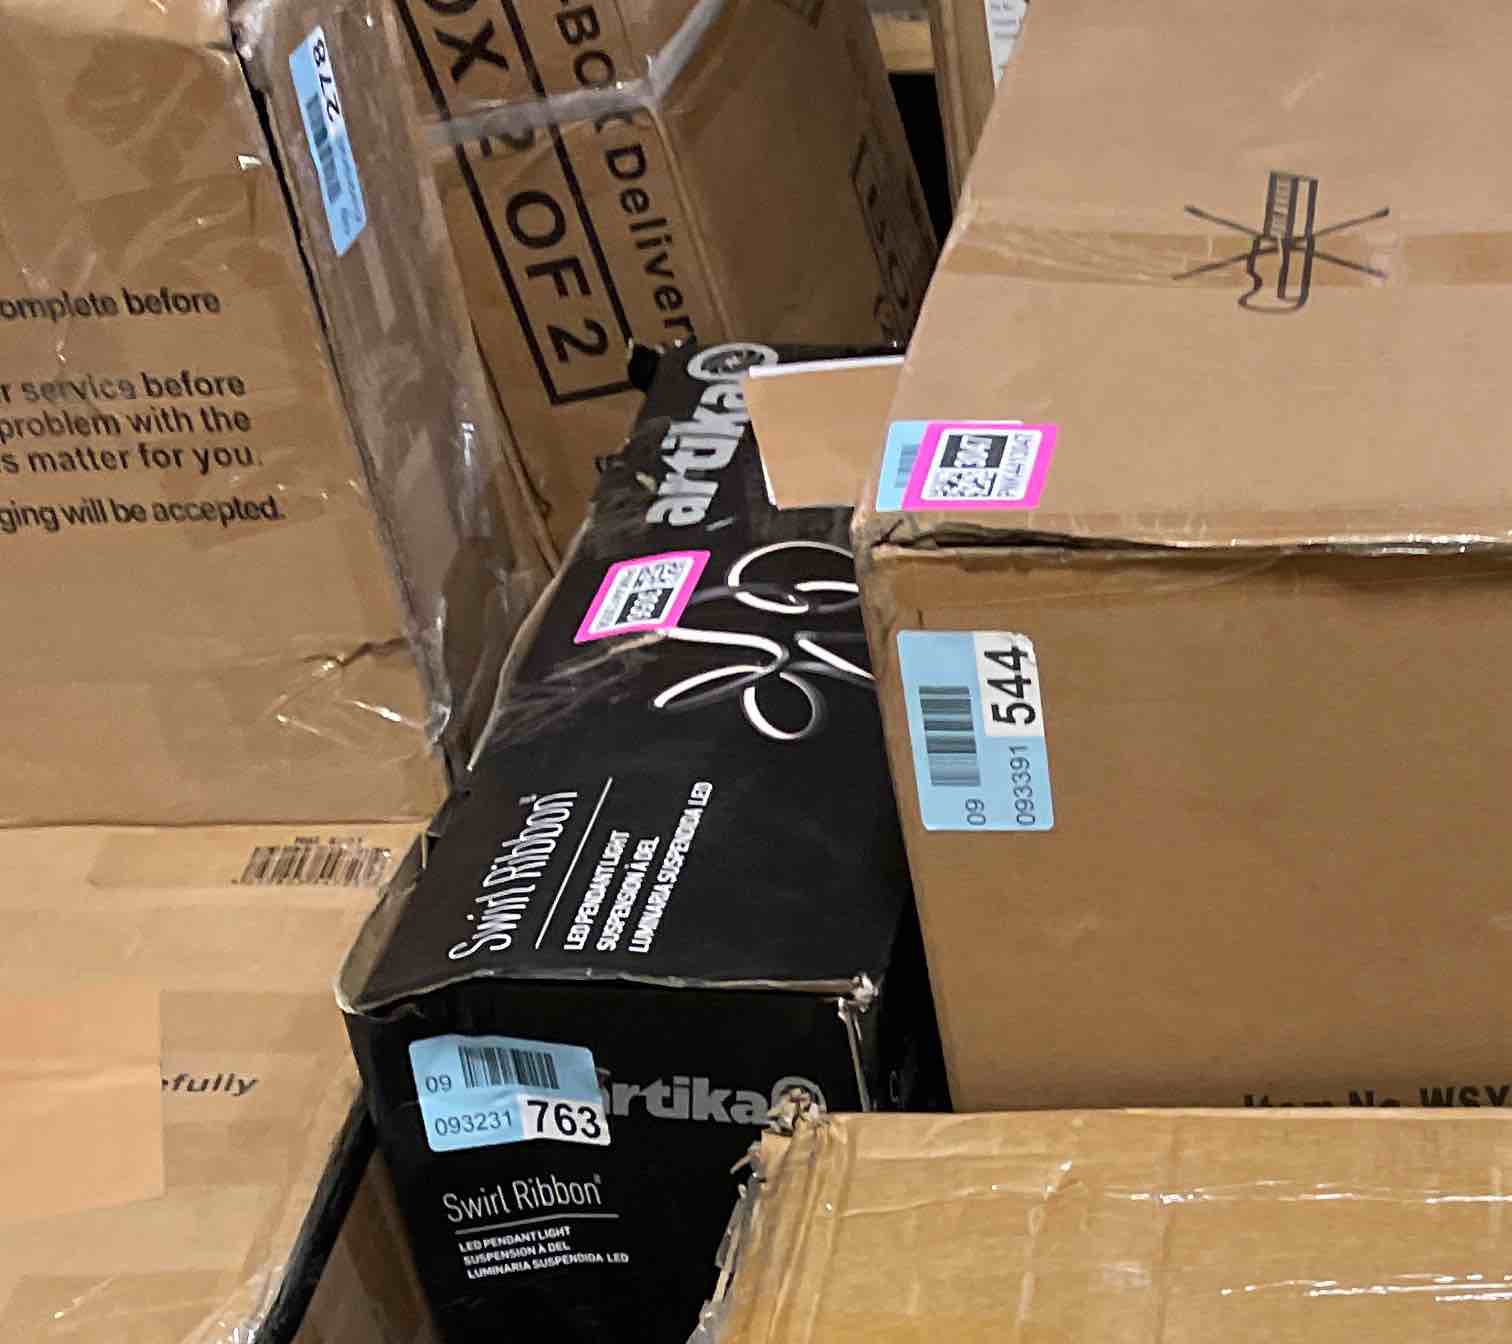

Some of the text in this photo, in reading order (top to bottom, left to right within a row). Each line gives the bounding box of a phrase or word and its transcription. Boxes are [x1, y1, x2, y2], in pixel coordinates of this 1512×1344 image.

[506, 190, 592, 298] OF
[606, 144, 694, 334] Deliver
[122, 287, 221, 316] before
[546, 320, 609, 363] 2
[21, 374, 137, 402] service
[140, 370, 247, 398] before
[0, 406, 250, 444] problem with the
[0, 443, 264, 475] s matter for you.
[64, 498, 108, 525] will
[112, 499, 146, 523] be
[153, 496, 287, 528] accepted.
[984, 646, 1036, 725] 544
[688, 782, 712, 806] LED
[1010, 745, 1036, 826] 093391
[965, 798, 986, 826] 09
[449, 884, 536, 960] Swirl
[425, 1076, 452, 1093] 09
[601, 1068, 770, 1125] rtika
[434, 1110, 513, 1136] 093231
[528, 1100, 600, 1138] 763
[443, 1185, 510, 1222] Swirl
[459, 1226, 570, 1252] LED PENDANT LIGHT
[464, 1246, 536, 1266] SUSPENSION
[548, 1241, 571, 1252] DEL
[467, 1252, 629, 1279] LUMINARIA SUSPENDIDA LED
